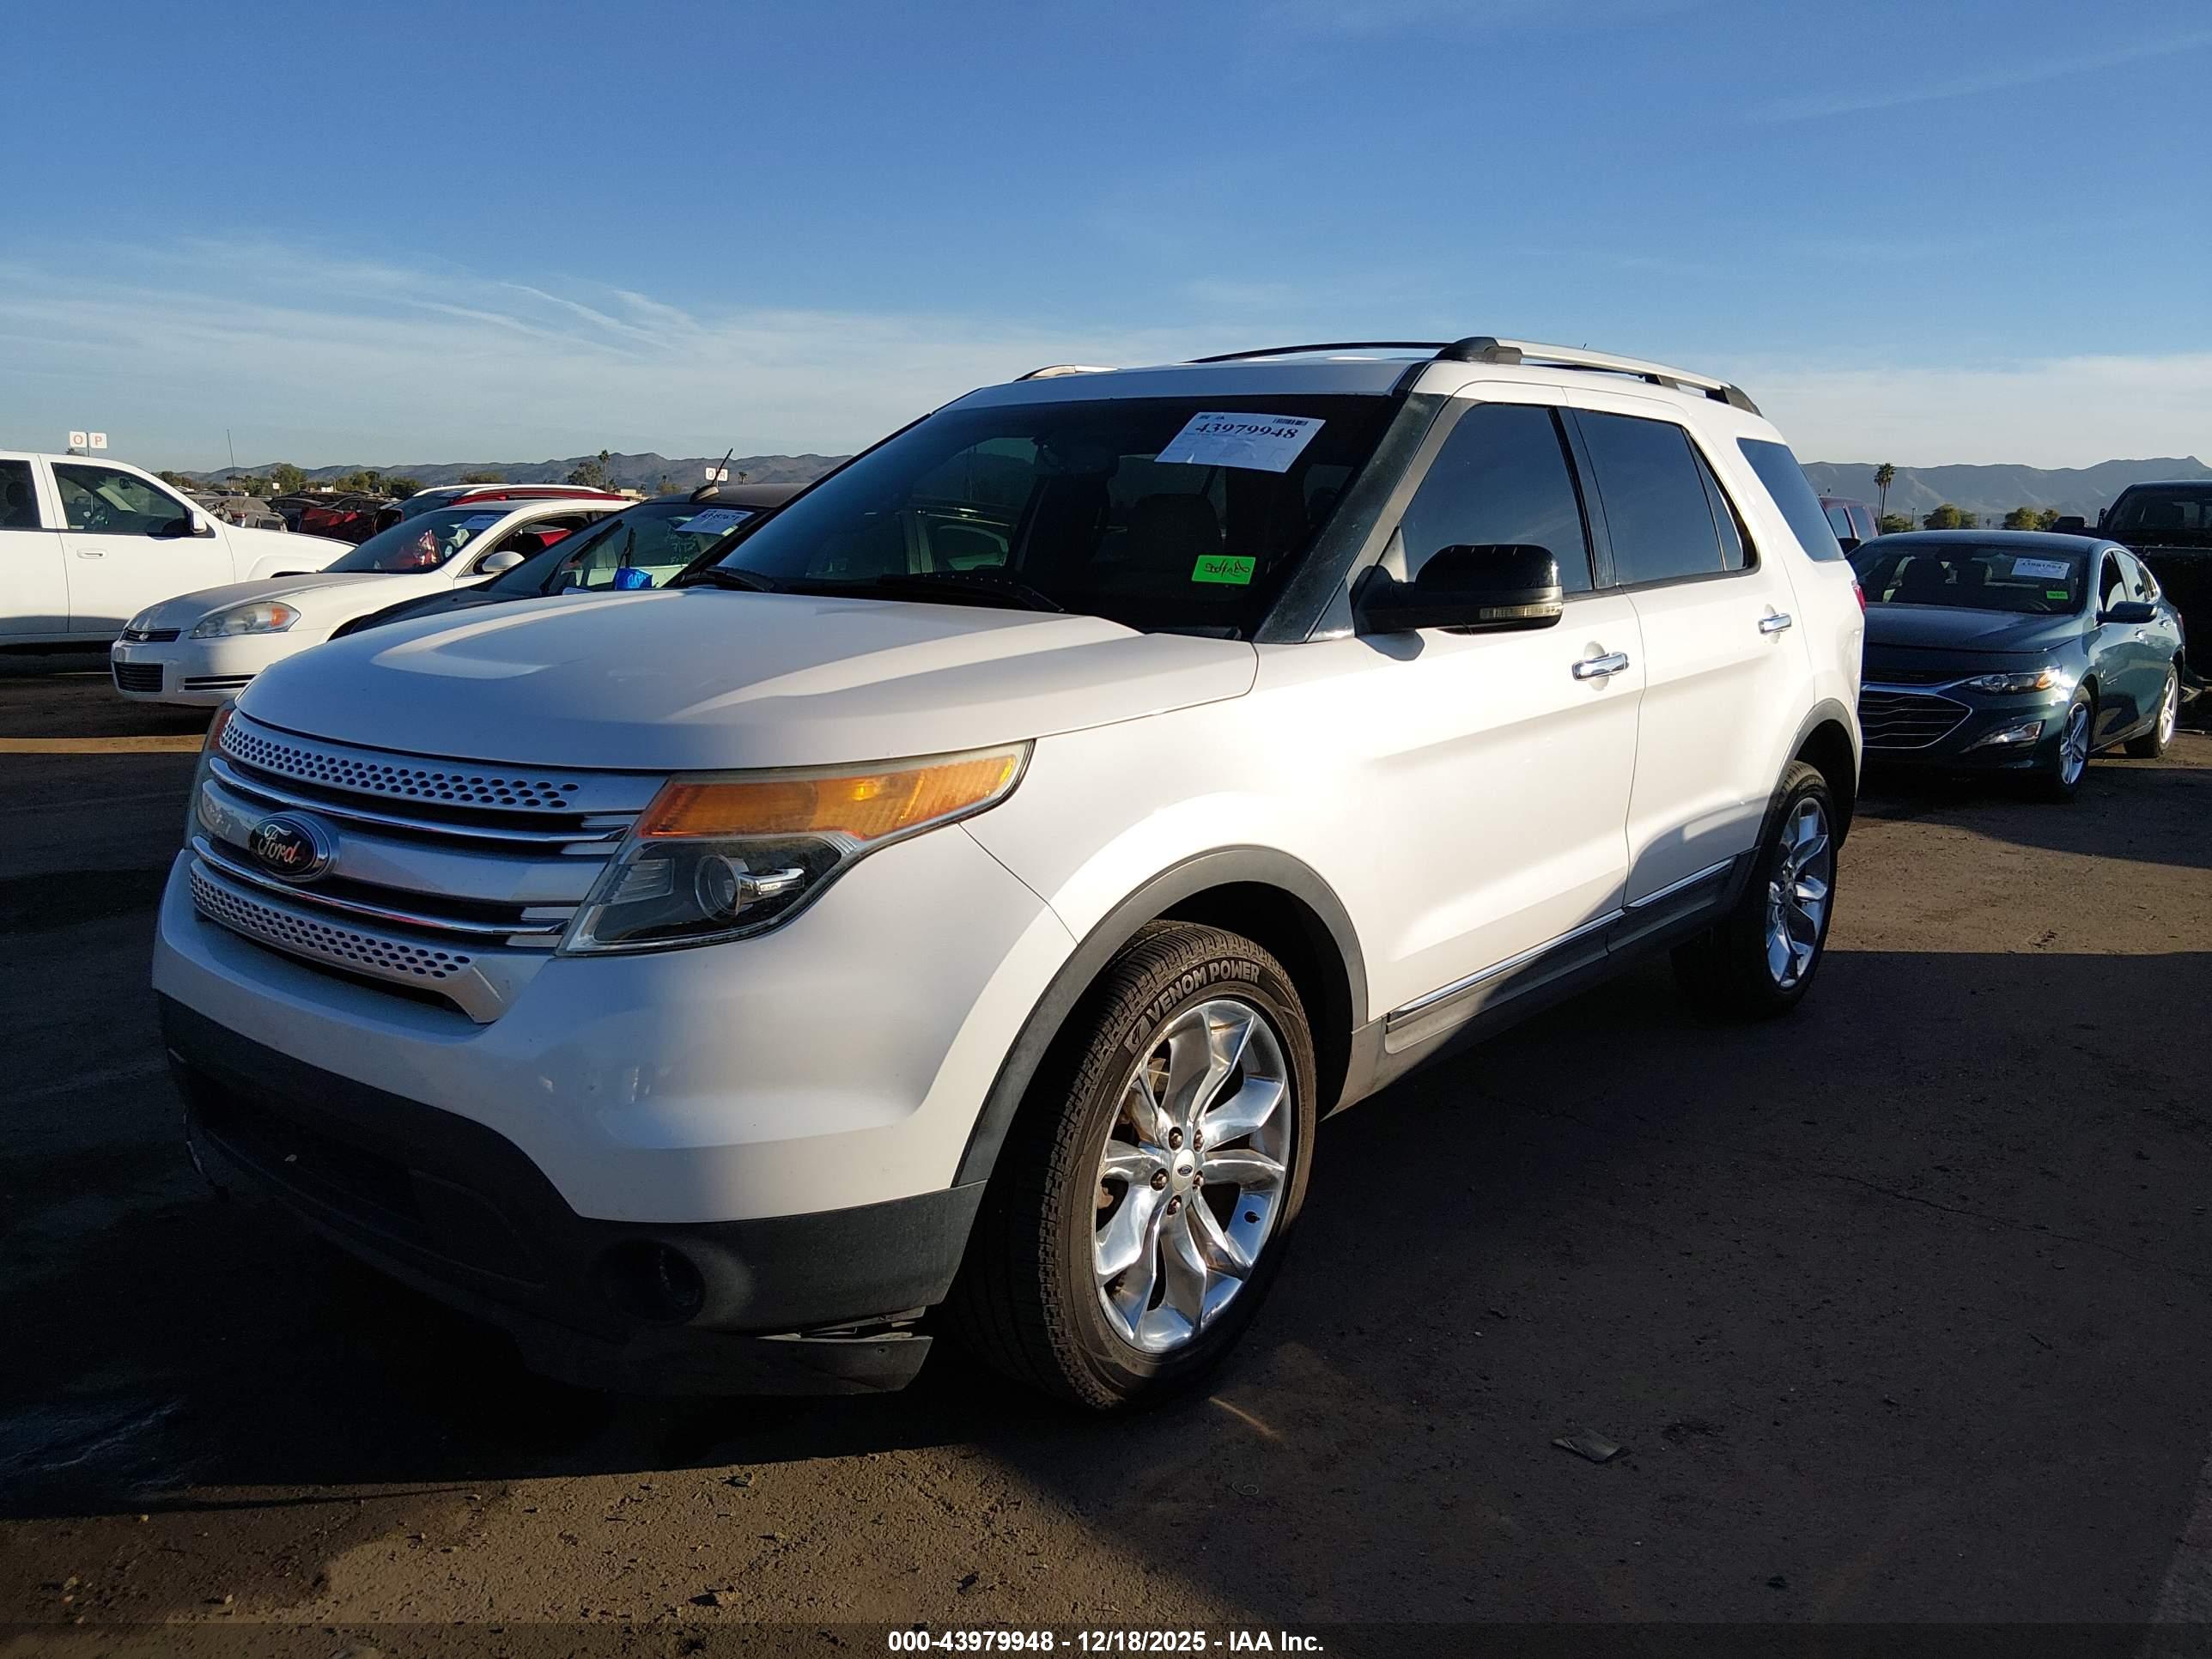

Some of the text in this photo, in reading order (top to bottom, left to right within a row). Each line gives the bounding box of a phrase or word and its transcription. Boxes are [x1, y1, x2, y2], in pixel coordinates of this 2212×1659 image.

[73, 434, 102, 446] O P
[1194, 422, 1299, 439] 43979948
[258, 823, 301, 864] Ford
[1146, 959, 1261, 1023] VENOM POWER
